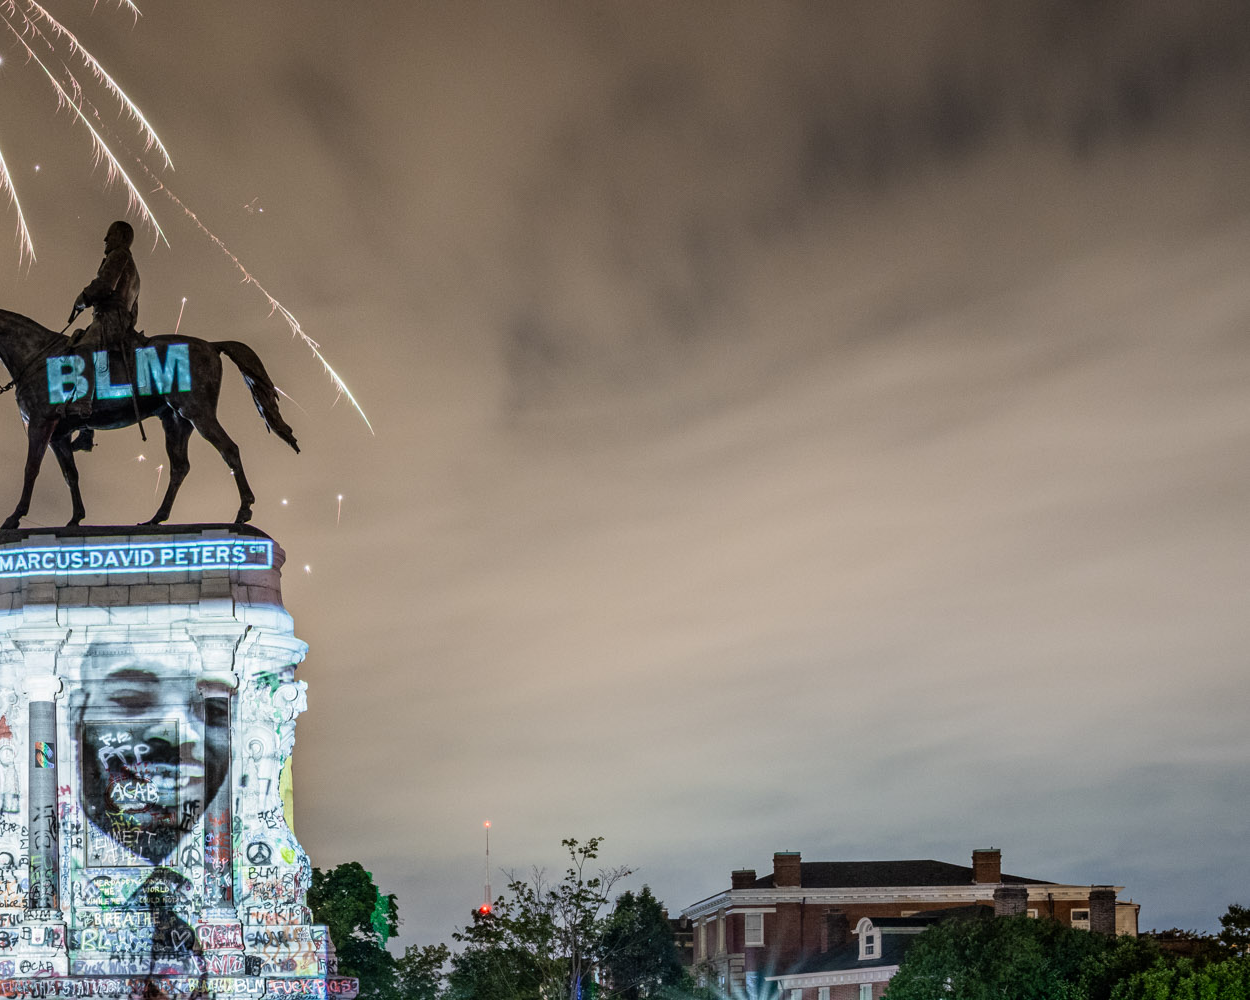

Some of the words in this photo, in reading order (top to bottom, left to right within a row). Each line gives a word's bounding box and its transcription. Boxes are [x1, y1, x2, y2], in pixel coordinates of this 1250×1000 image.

[46, 343, 192, 404] BLM
[0, 550, 155, 572] MARCUS-DAVID
[161, 546, 246, 566] PETERS
[111, 782, 159, 803] ACAB
[249, 867, 278, 880] BLM
[94, 912, 160, 926] BREATHE
[235, 979, 265, 993] BLM
[269, 980, 311, 995] FUCK
